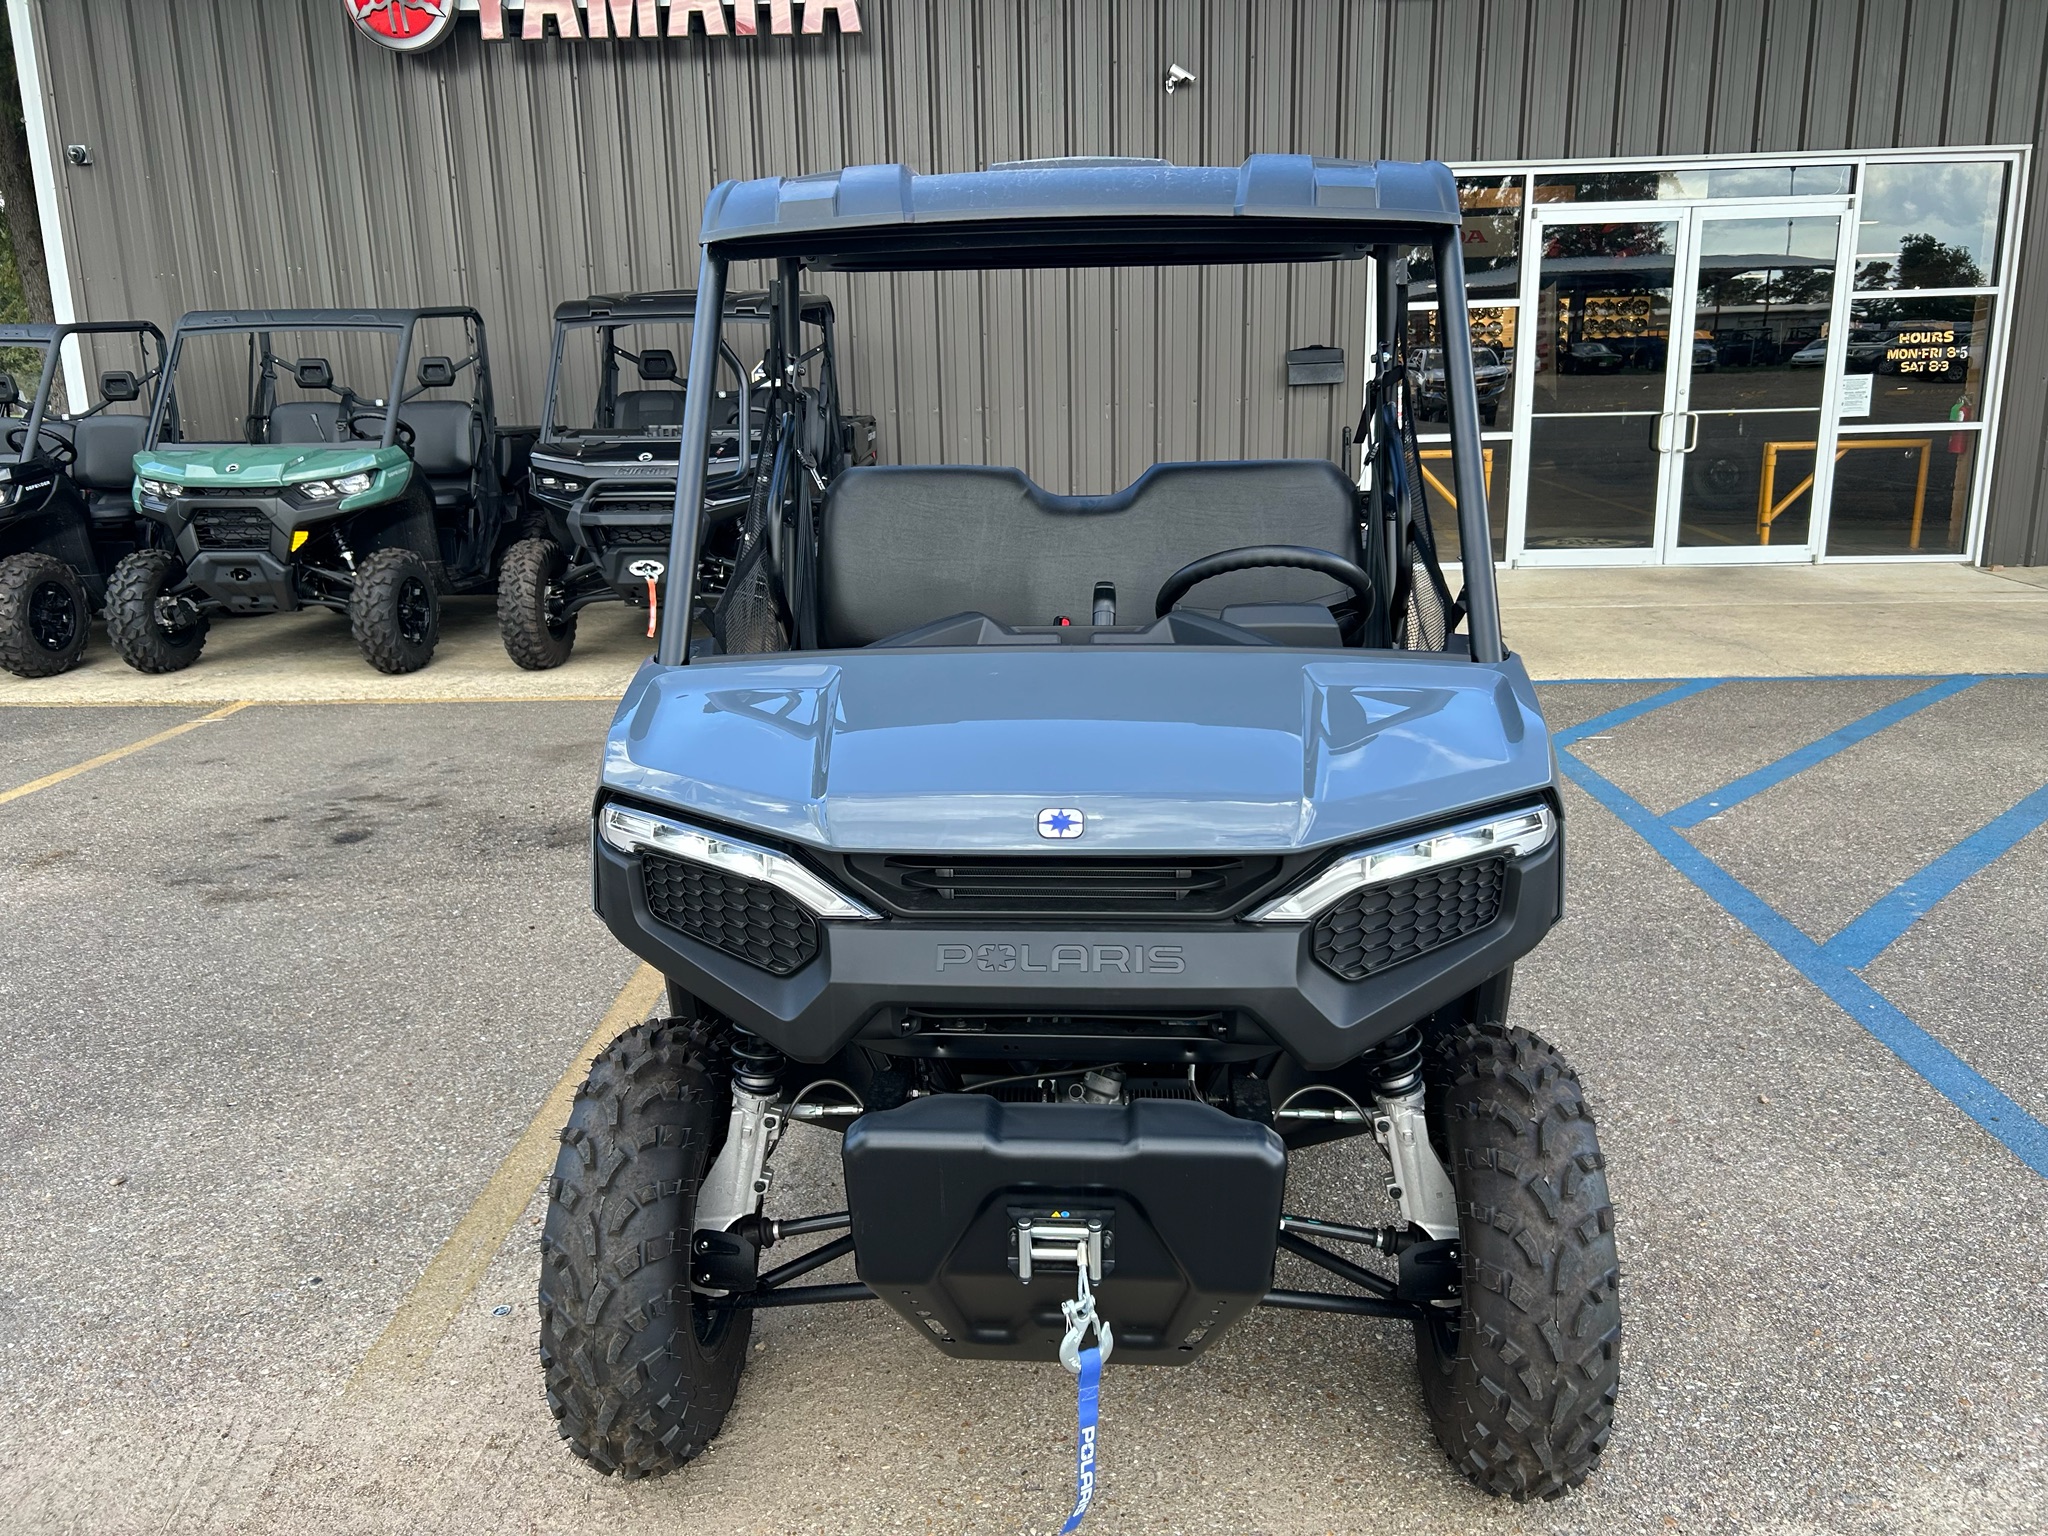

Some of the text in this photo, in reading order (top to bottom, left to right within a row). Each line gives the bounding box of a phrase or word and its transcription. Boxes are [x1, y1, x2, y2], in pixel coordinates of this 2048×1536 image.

[1899, 331, 1954, 344] HOURS
[1947, 346, 1968, 359] 8-5
[1900, 361, 1949, 372] SAT 8-3
[936, 943, 1186, 974] POLARIS
[1073, 1426, 1095, 1517] POLARIS
